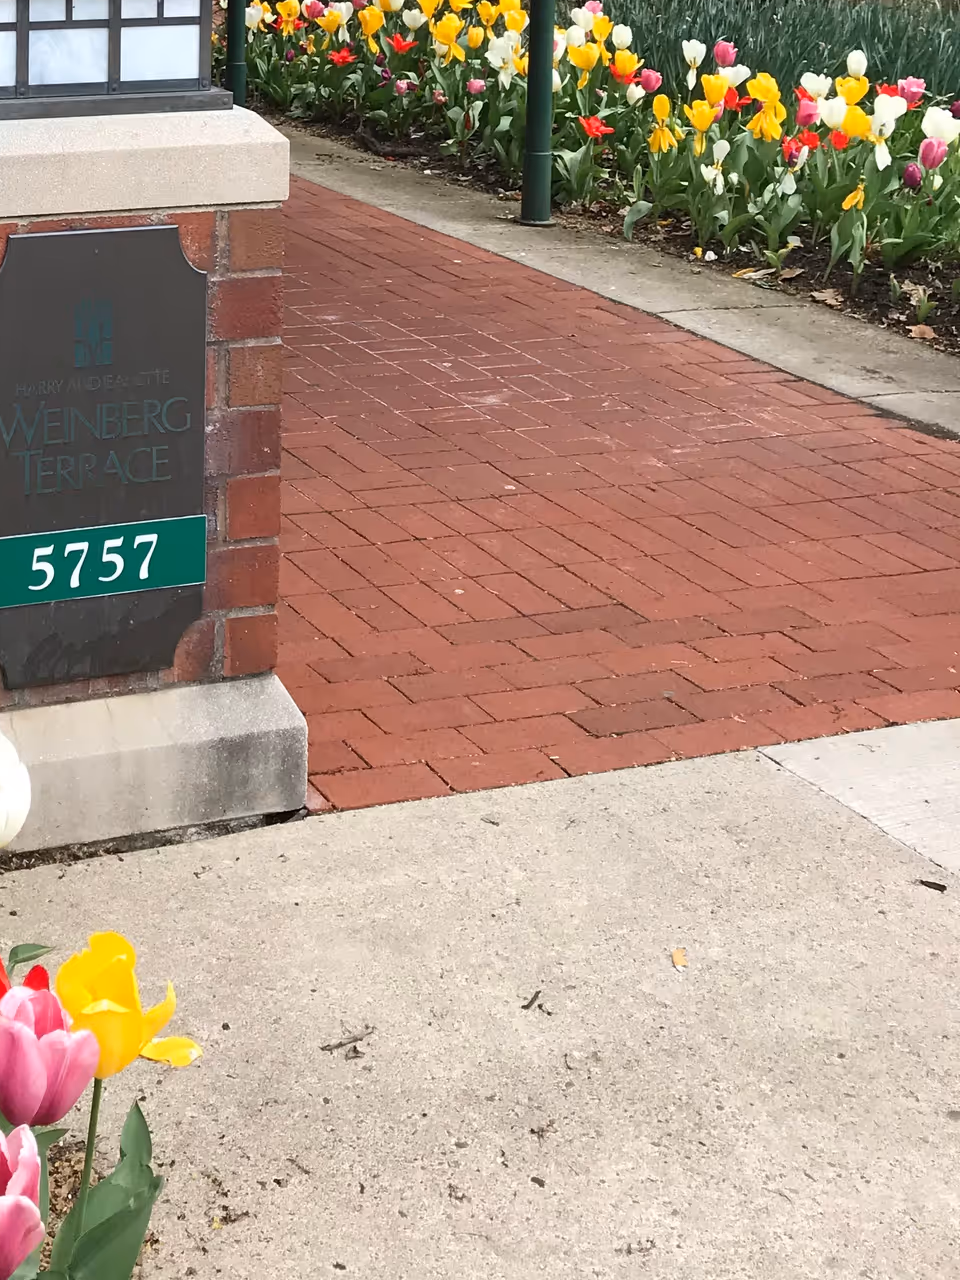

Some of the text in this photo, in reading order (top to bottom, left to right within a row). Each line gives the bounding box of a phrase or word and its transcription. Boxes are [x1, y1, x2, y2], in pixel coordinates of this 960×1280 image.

[16, 379, 64, 397] HARRY
[9, 445, 172, 496] TERRACE
[28, 533, 158, 591] 5757
